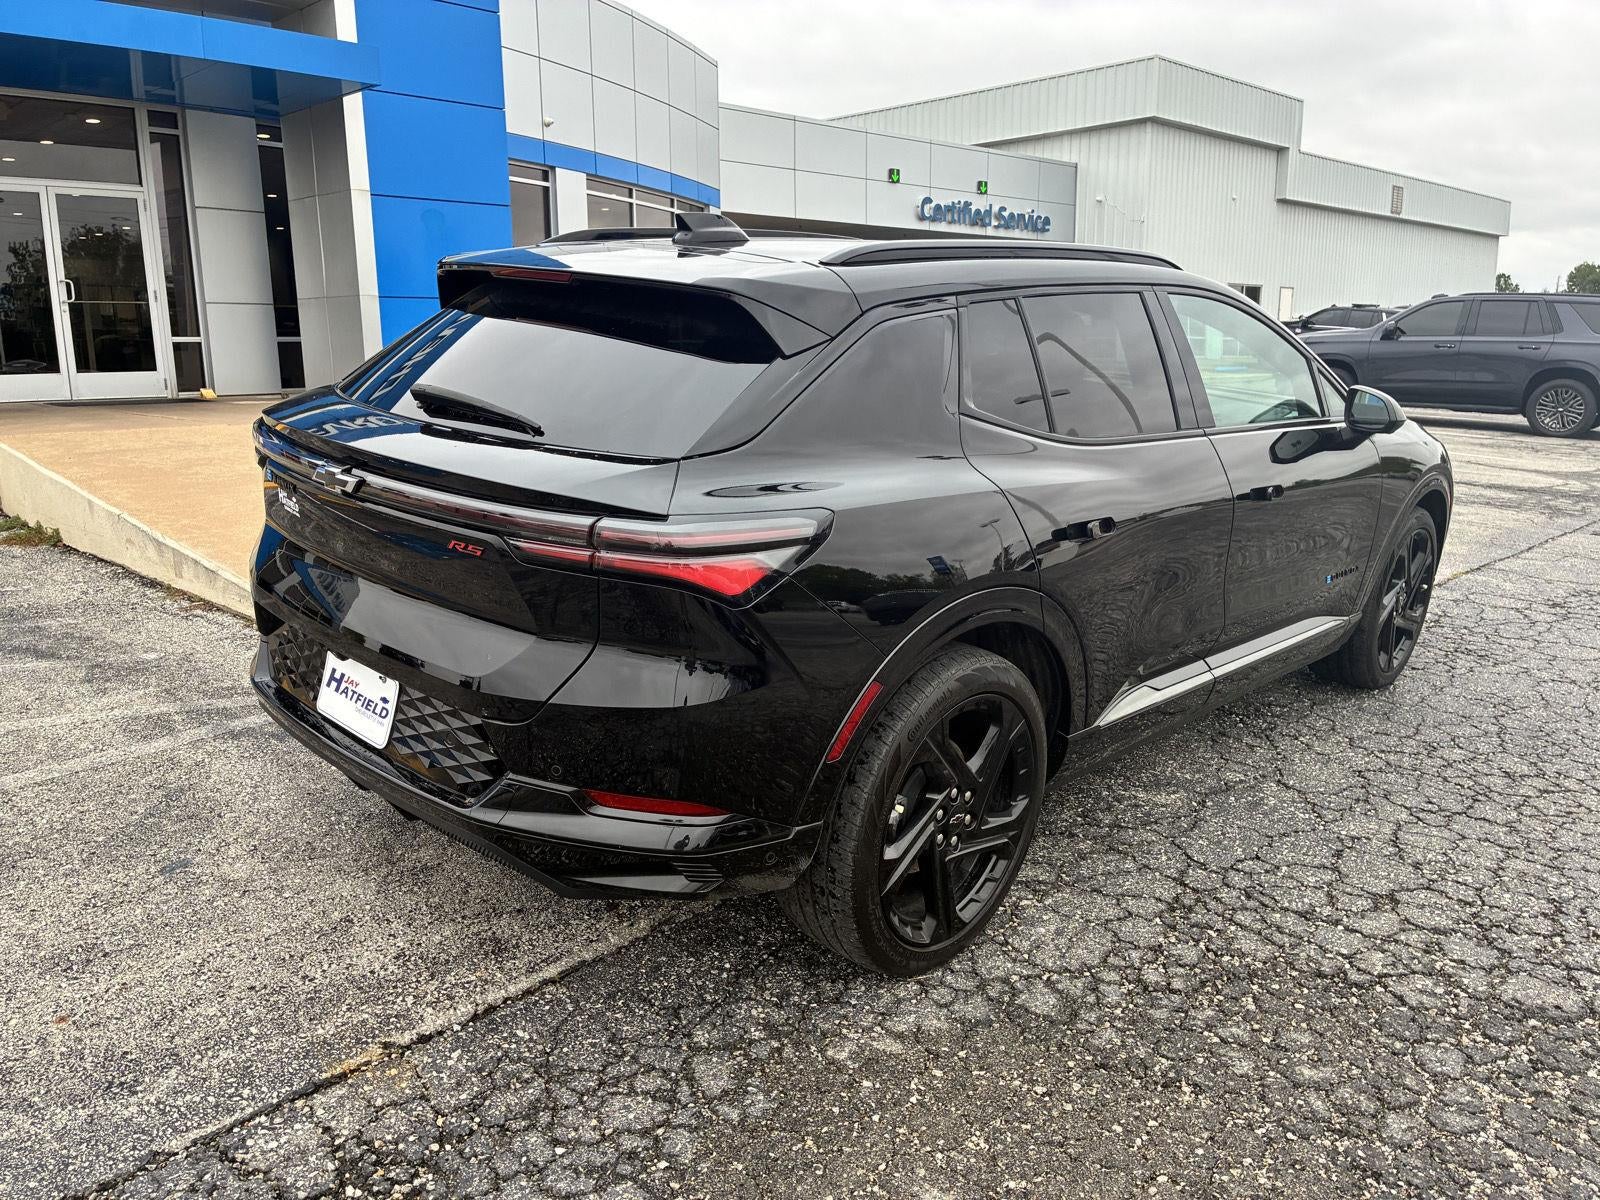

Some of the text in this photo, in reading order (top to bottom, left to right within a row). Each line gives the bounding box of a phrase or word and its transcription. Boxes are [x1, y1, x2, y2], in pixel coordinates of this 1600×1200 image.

[919, 196, 1051, 233] Certified Service
[448, 540, 484, 556] RS
[326, 667, 389, 719] HATFIELD
[343, 676, 360, 689] JAY
